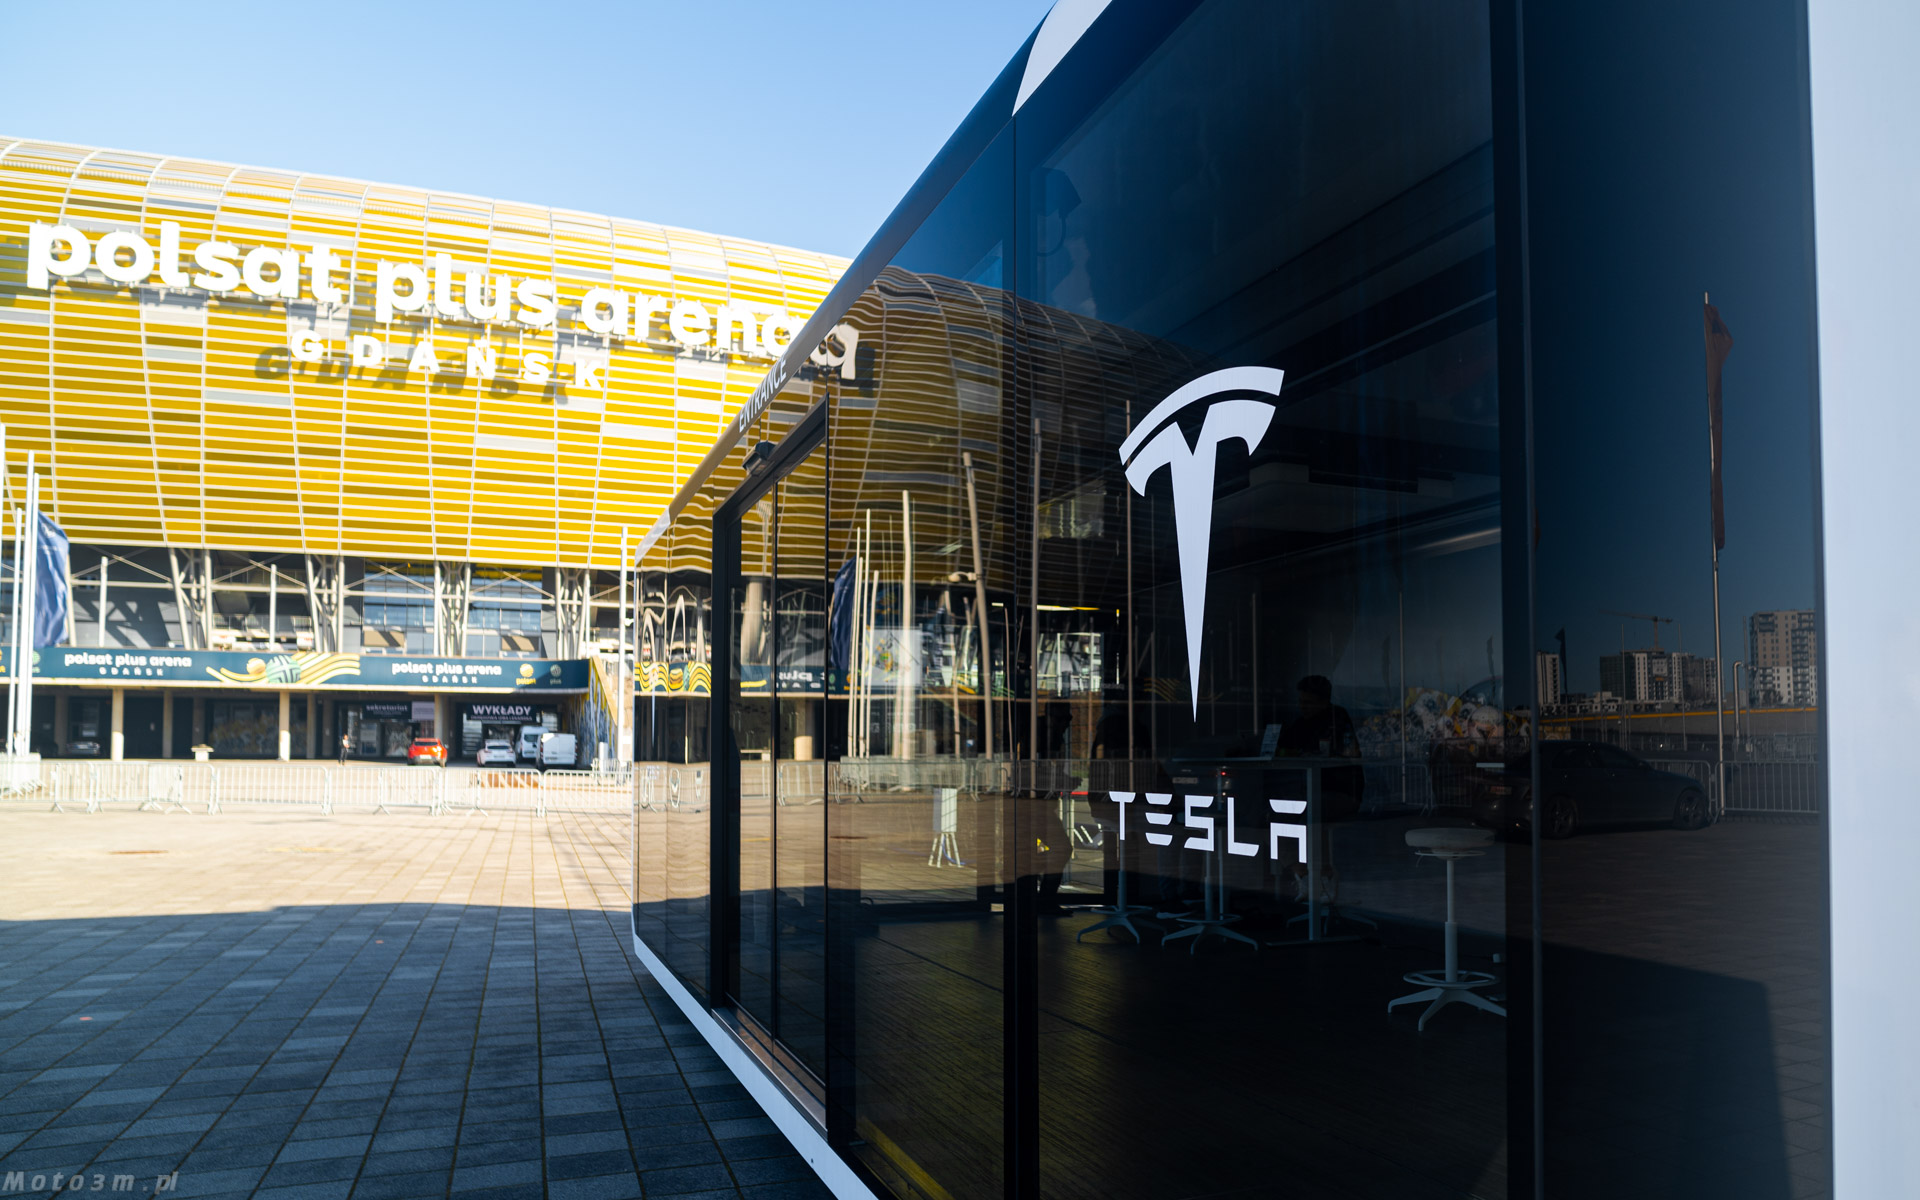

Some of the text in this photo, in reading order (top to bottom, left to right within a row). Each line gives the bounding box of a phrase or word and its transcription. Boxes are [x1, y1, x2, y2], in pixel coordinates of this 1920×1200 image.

[27, 220, 342, 302] polsat
[375, 252, 556, 326] plus
[291, 330, 602, 390] GDAŃSK
[739, 355, 787, 433] ENTRANCE
[64, 652, 193, 667] polsat plus arena
[391, 661, 503, 676] polsat plus arena
[472, 704, 531, 715] WYKŁADY
[1108, 791, 1308, 863] TESLA
